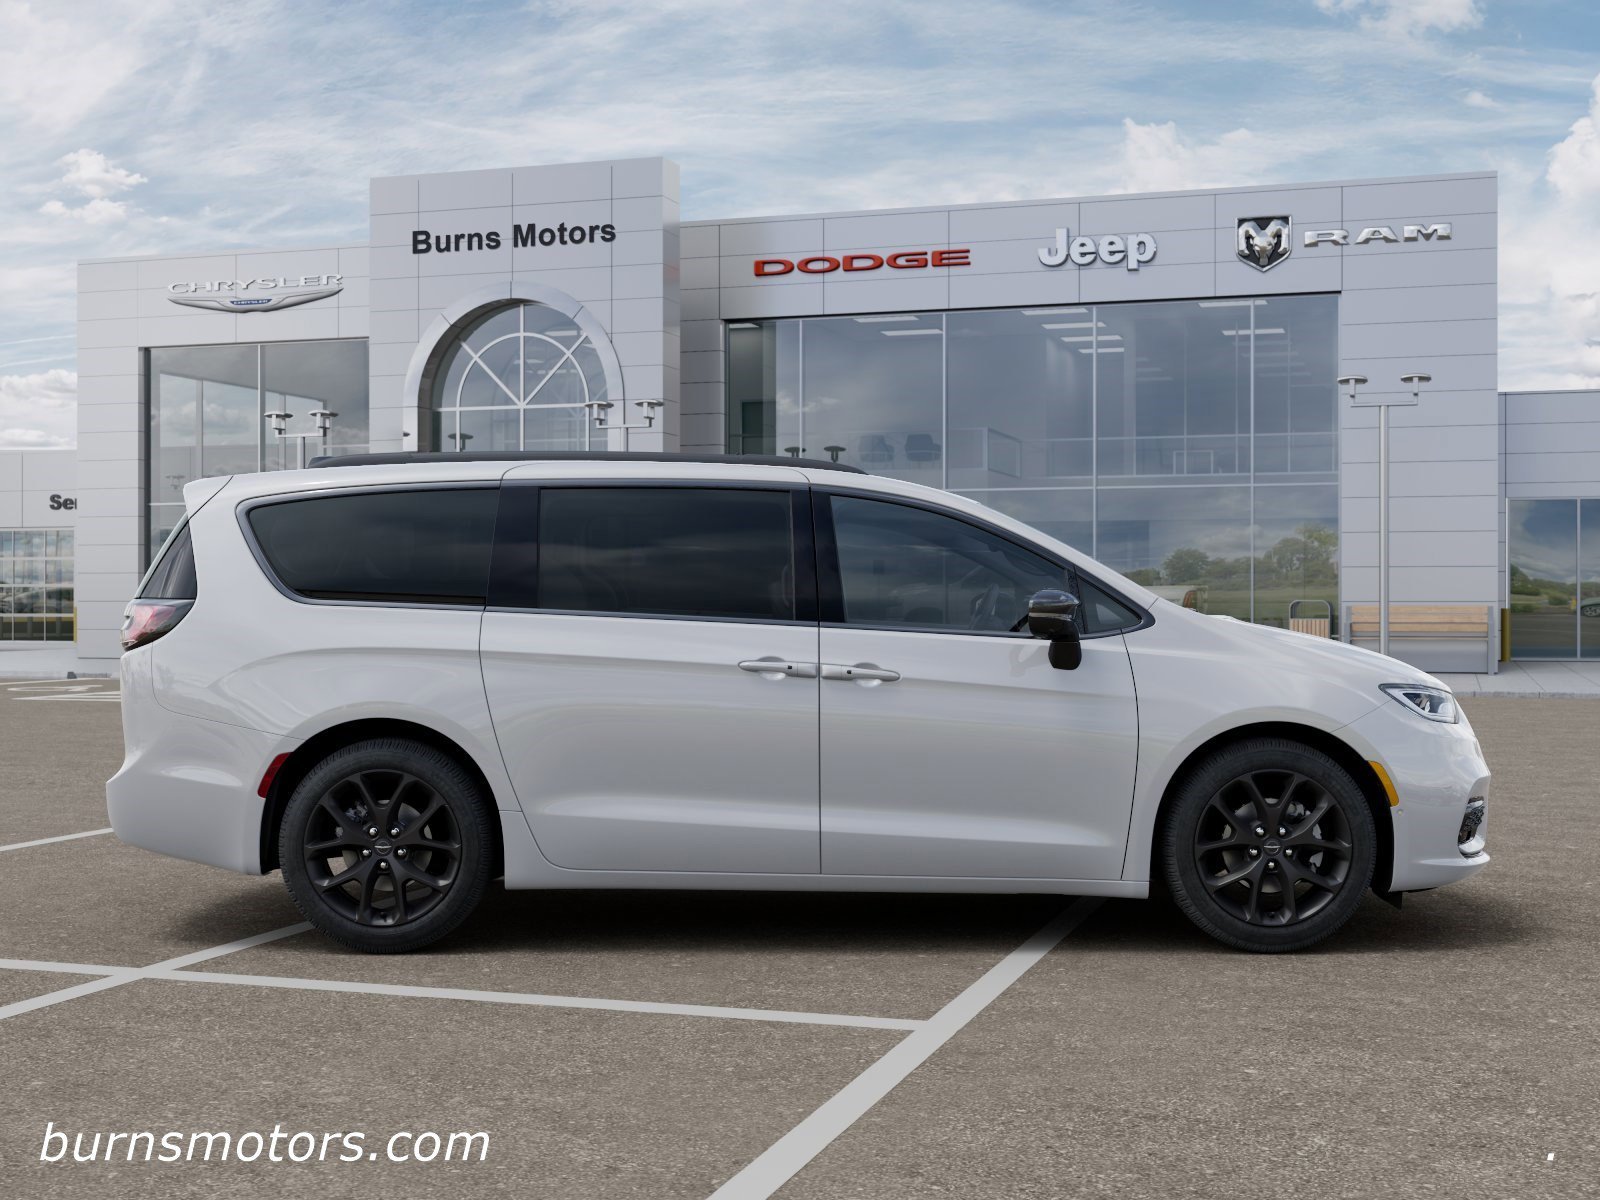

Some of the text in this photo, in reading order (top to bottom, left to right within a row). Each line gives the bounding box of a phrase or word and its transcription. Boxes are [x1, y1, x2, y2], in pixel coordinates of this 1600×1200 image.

[412, 222, 617, 255] Burns Motors
[1037, 227, 1158, 272] Jeep
[1304, 222, 1452, 248] RAM
[754, 248, 972, 277] DODGE
[167, 273, 344, 294] CHRYSLER
